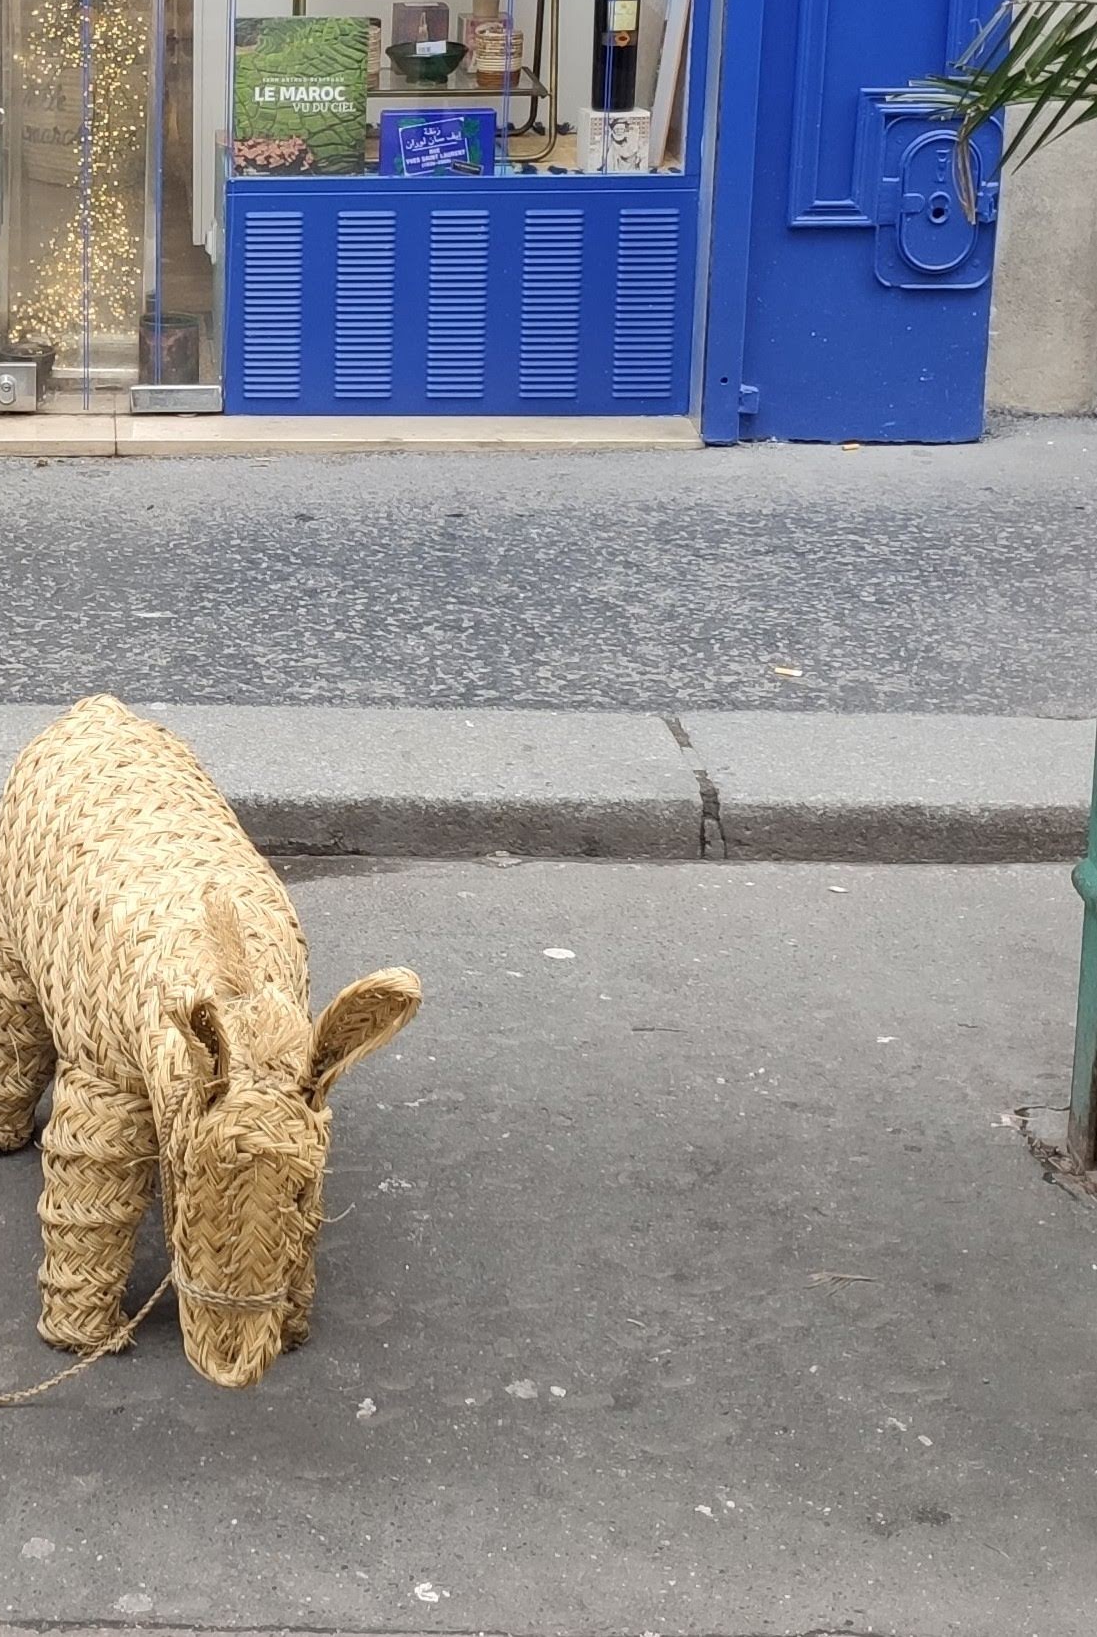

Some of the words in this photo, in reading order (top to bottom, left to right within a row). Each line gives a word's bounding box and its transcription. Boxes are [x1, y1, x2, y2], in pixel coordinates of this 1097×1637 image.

[254, 86, 276, 102] LE
[279, 85, 346, 102] MAROC
[292, 102, 310, 113] VU
[312, 102, 329, 113] DU
[330, 102, 357, 113] CIEL
